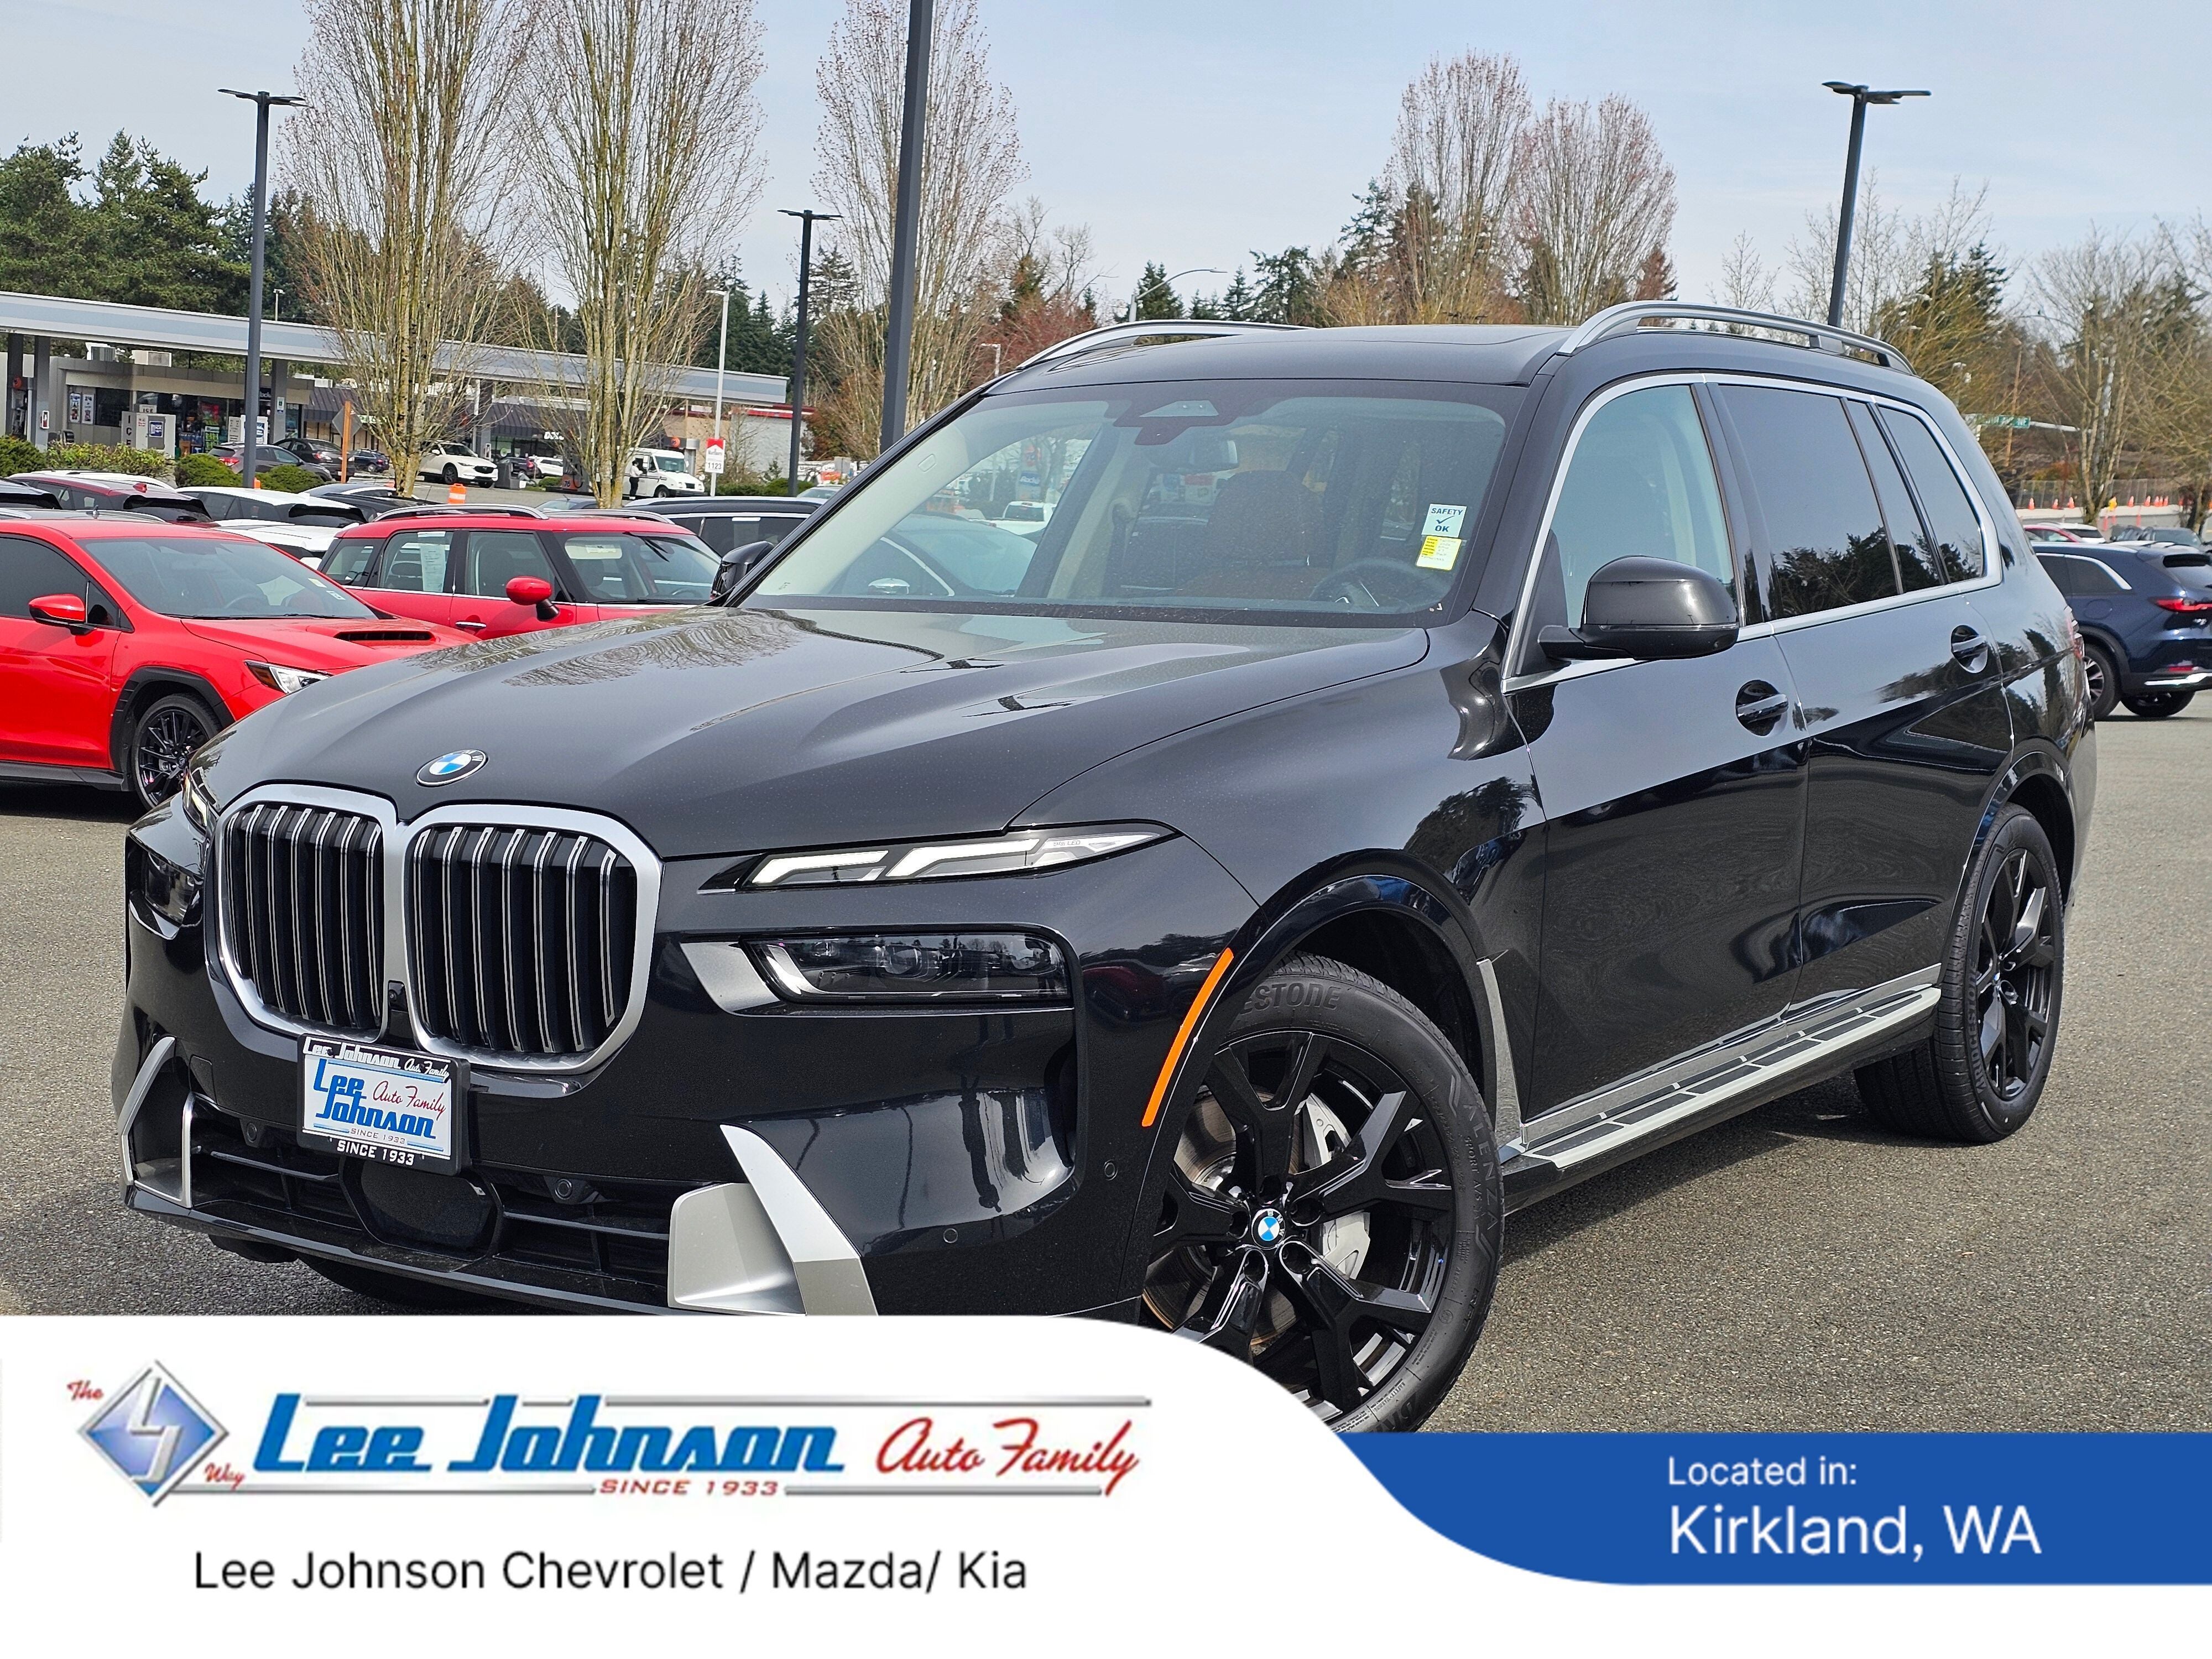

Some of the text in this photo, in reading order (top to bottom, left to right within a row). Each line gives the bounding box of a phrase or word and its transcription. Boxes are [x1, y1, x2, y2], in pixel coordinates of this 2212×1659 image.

[708, 462, 722, 470] 1123
[333, 1042, 401, 1070] Johnson
[422, 1060, 450, 1081] Family
[313, 1058, 447, 1121] Lee Auto Family
[316, 1091, 436, 1140] Johnson
[337, 1140, 415, 1166] SINCE 1933
[349, 1128, 406, 1145] SINCE 1933
[1463, 1104, 1498, 1230] ALENZA
[1465, 1137, 1479, 1174] SPORT
[1267, 1210, 1285, 1237] BMW
